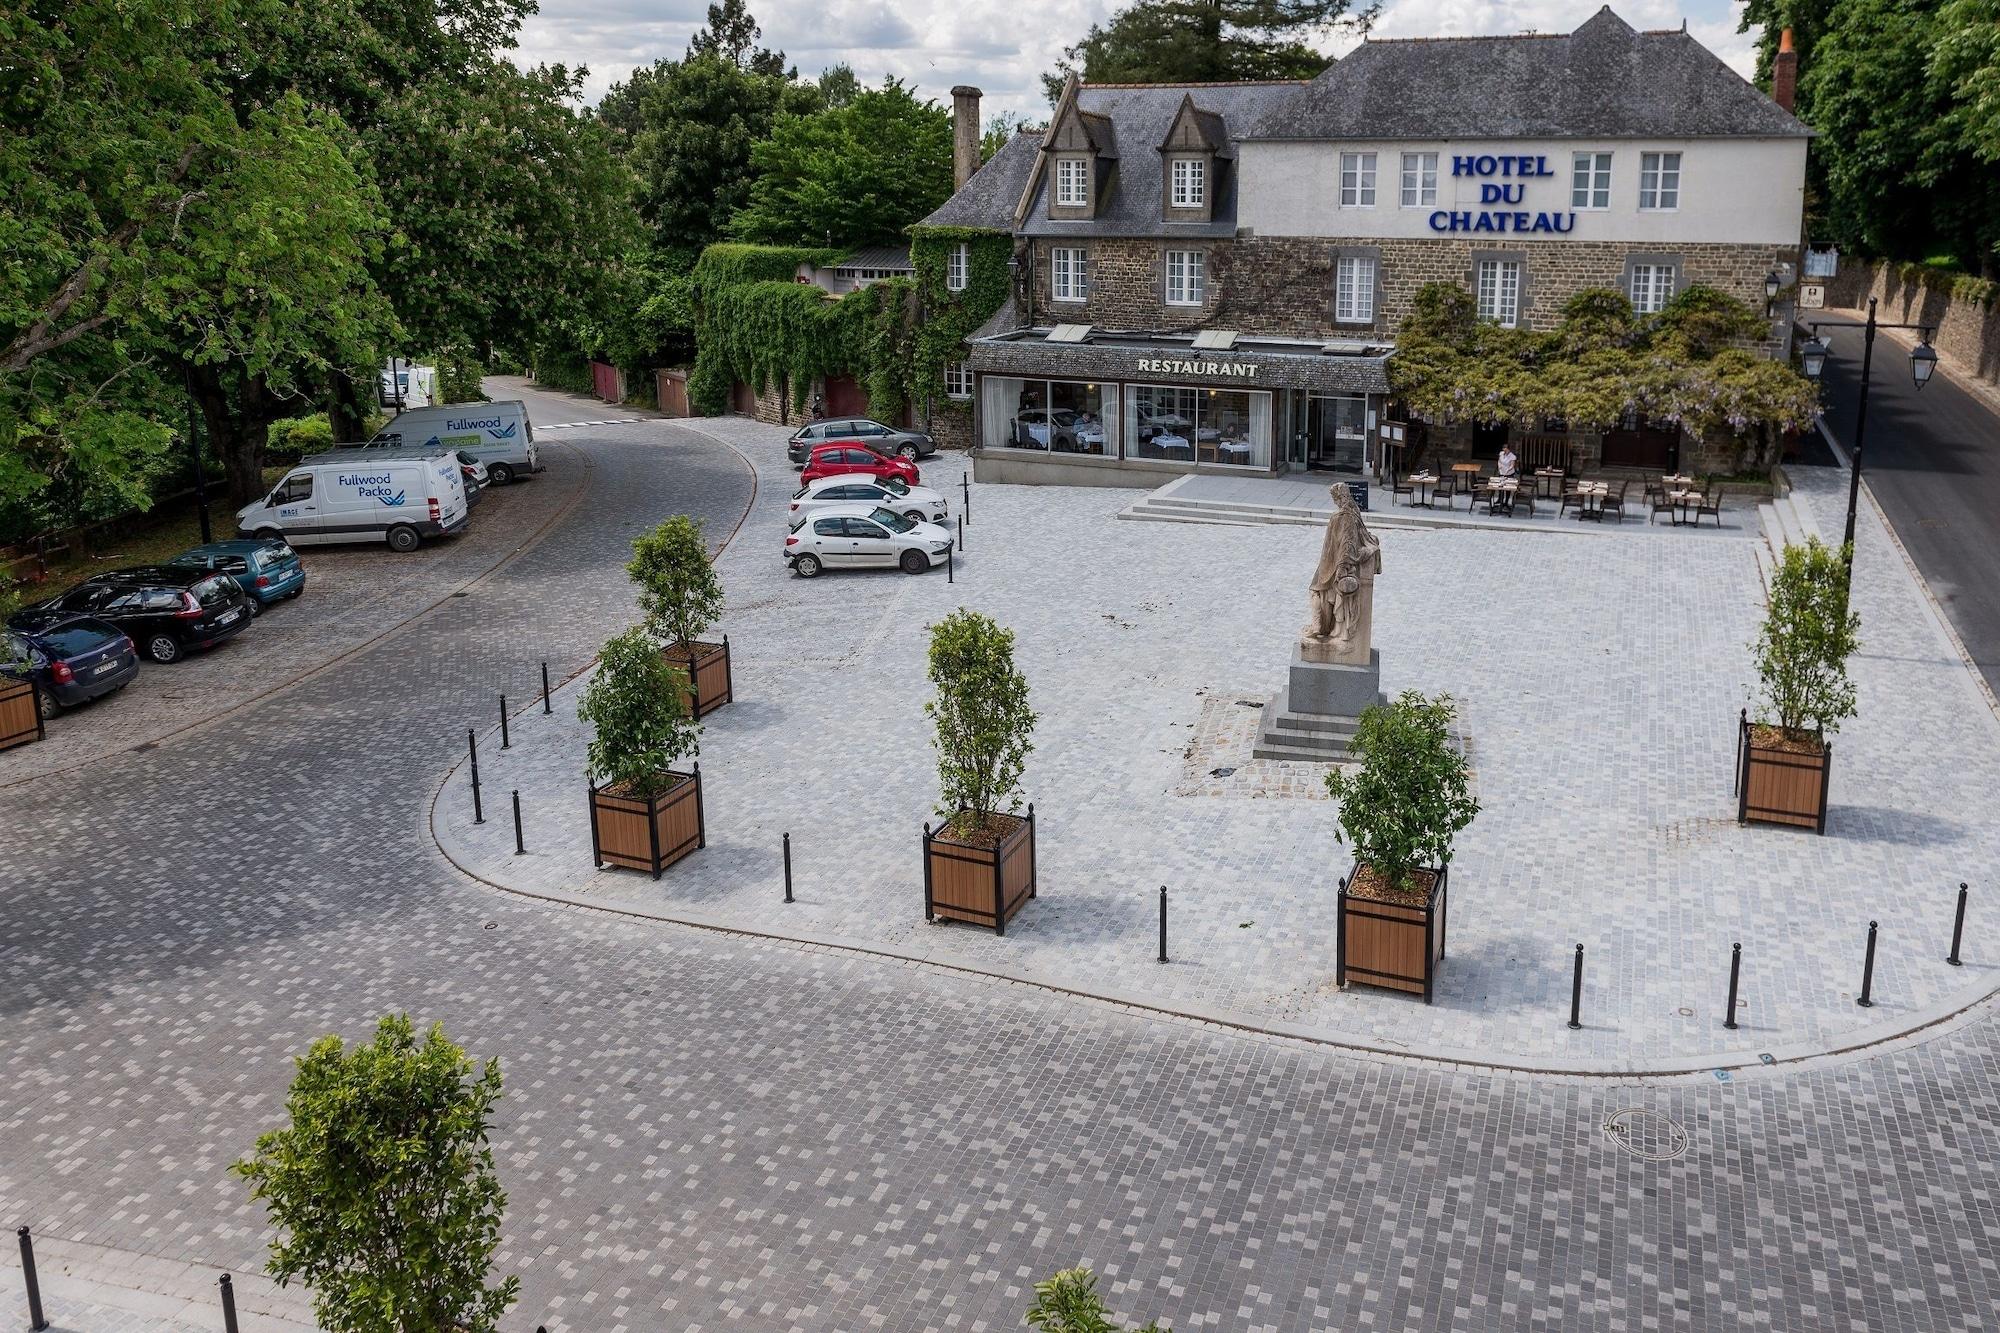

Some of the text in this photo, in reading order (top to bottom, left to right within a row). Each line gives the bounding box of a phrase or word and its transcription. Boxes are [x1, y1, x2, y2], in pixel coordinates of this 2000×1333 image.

[1452, 155, 1554, 177] HOTEL
[1480, 184, 1525, 204] DU
[1429, 211, 1576, 233] CHATEAU
[1138, 359, 1258, 377] RESTAURANT
[447, 416, 501, 431] Fullwood
[338, 473, 391, 486] Fullwood
[359, 486, 392, 497] Packo
